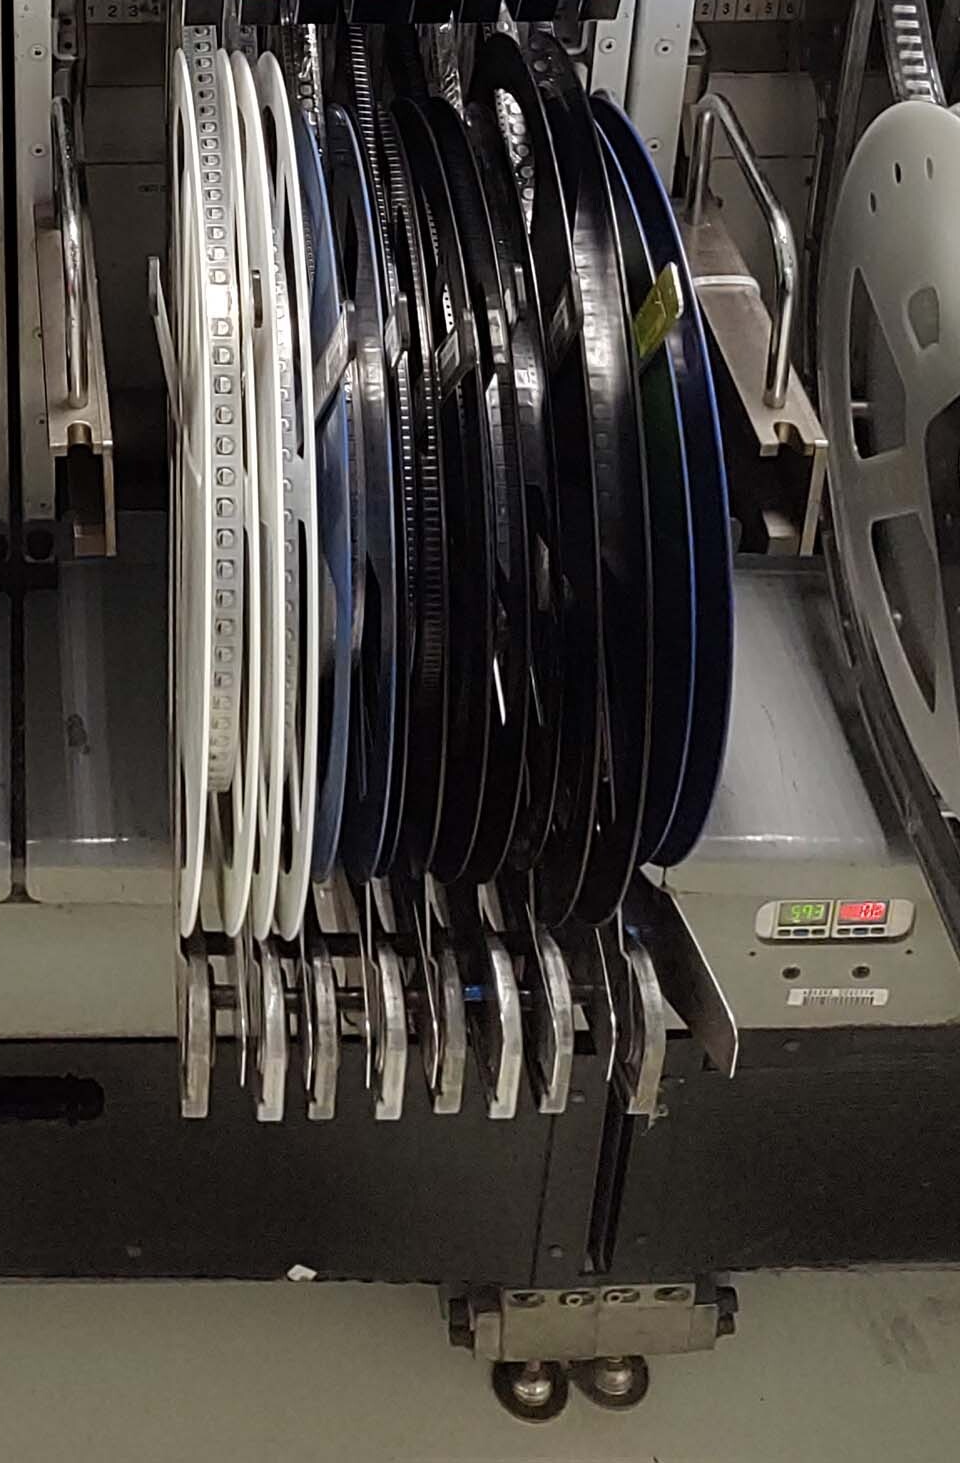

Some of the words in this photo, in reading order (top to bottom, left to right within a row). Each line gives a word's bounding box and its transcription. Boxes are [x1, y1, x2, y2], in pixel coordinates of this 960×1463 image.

[107, 5, 118, 17] 2
[127, 5, 138, 17] 3
[701, 2, 710, 15] 2
[722, 2, 730, 15] 3
